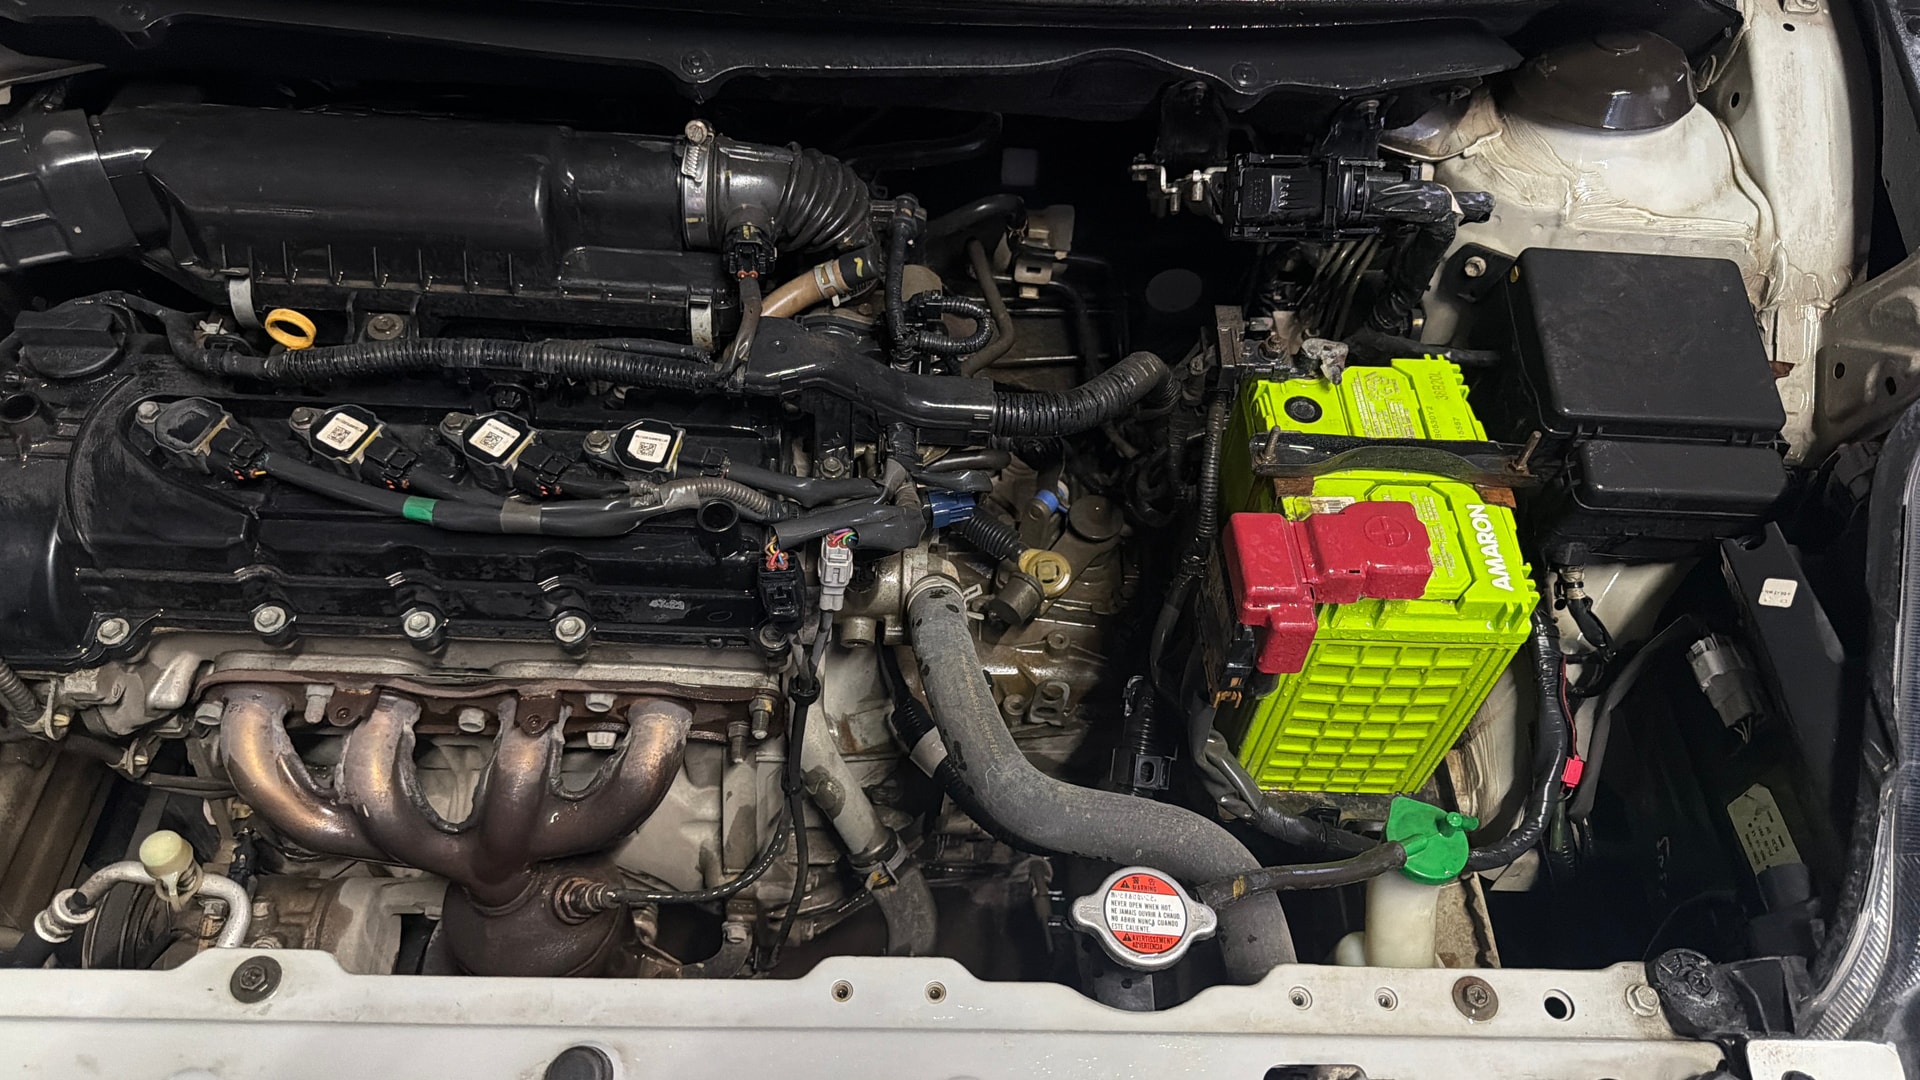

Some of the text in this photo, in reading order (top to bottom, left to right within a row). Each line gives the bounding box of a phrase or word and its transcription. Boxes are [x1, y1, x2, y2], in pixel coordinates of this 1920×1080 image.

[1466, 504, 1514, 592] AMARON
[1129, 901, 1142, 909] OPEN
[1119, 908, 1136, 916] JAMAIS
[1138, 910, 1156, 918] OUVRIR
[1121, 916, 1136, 924] ABRIR
[1138, 918, 1155, 926] NUNCA
[1157, 919, 1179, 927] CUANDO
[1132, 934, 1174, 944] AVERTISSEMENT
[1132, 941, 1163, 950] ADVERTENCIA
